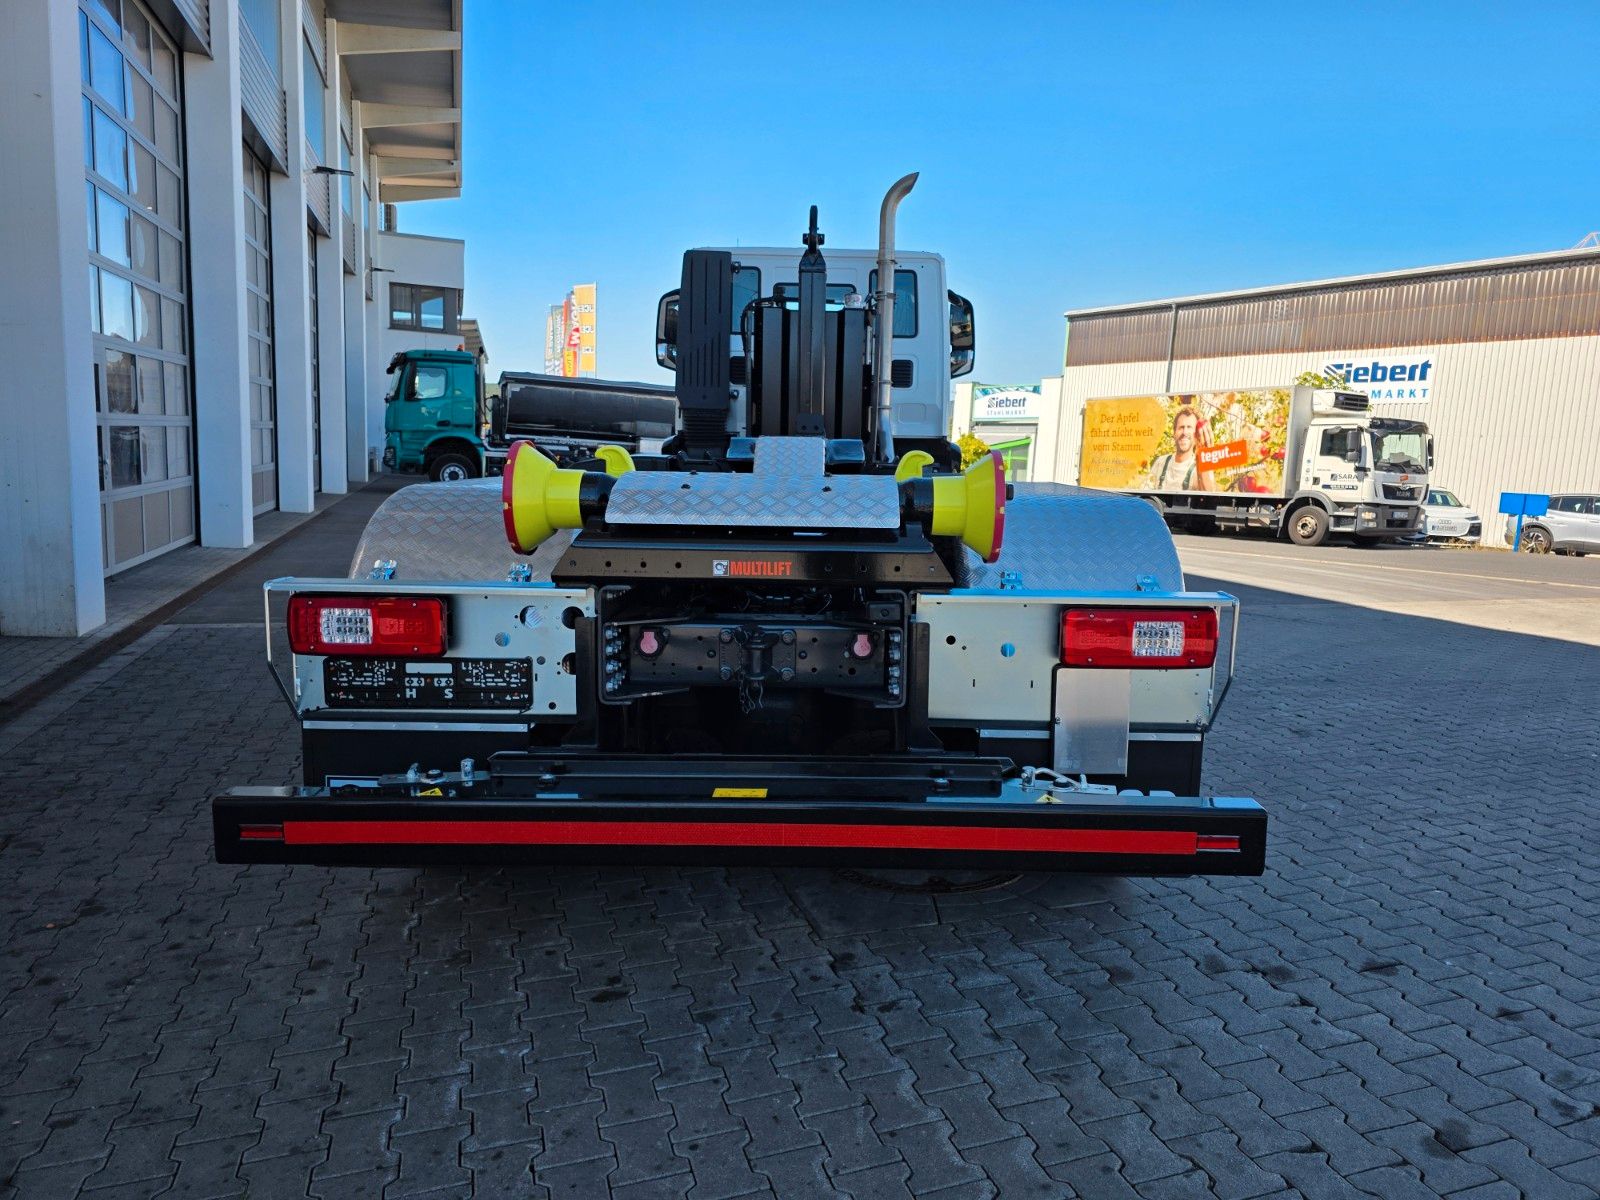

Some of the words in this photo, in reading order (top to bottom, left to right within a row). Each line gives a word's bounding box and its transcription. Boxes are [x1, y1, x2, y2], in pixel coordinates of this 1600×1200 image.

[1371, 388, 1429, 399] MARKT
[988, 397, 1027, 408] Siebert
[1100, 414, 1114, 424] Der
[1116, 412, 1140, 425] Apfel
[1112, 427, 1133, 437] nicht
[1135, 427, 1154, 437] weit
[1092, 444, 1110, 452] vom
[1200, 446, 1242, 464] tegut...
[730, 560, 793, 576] MULTILIFT
